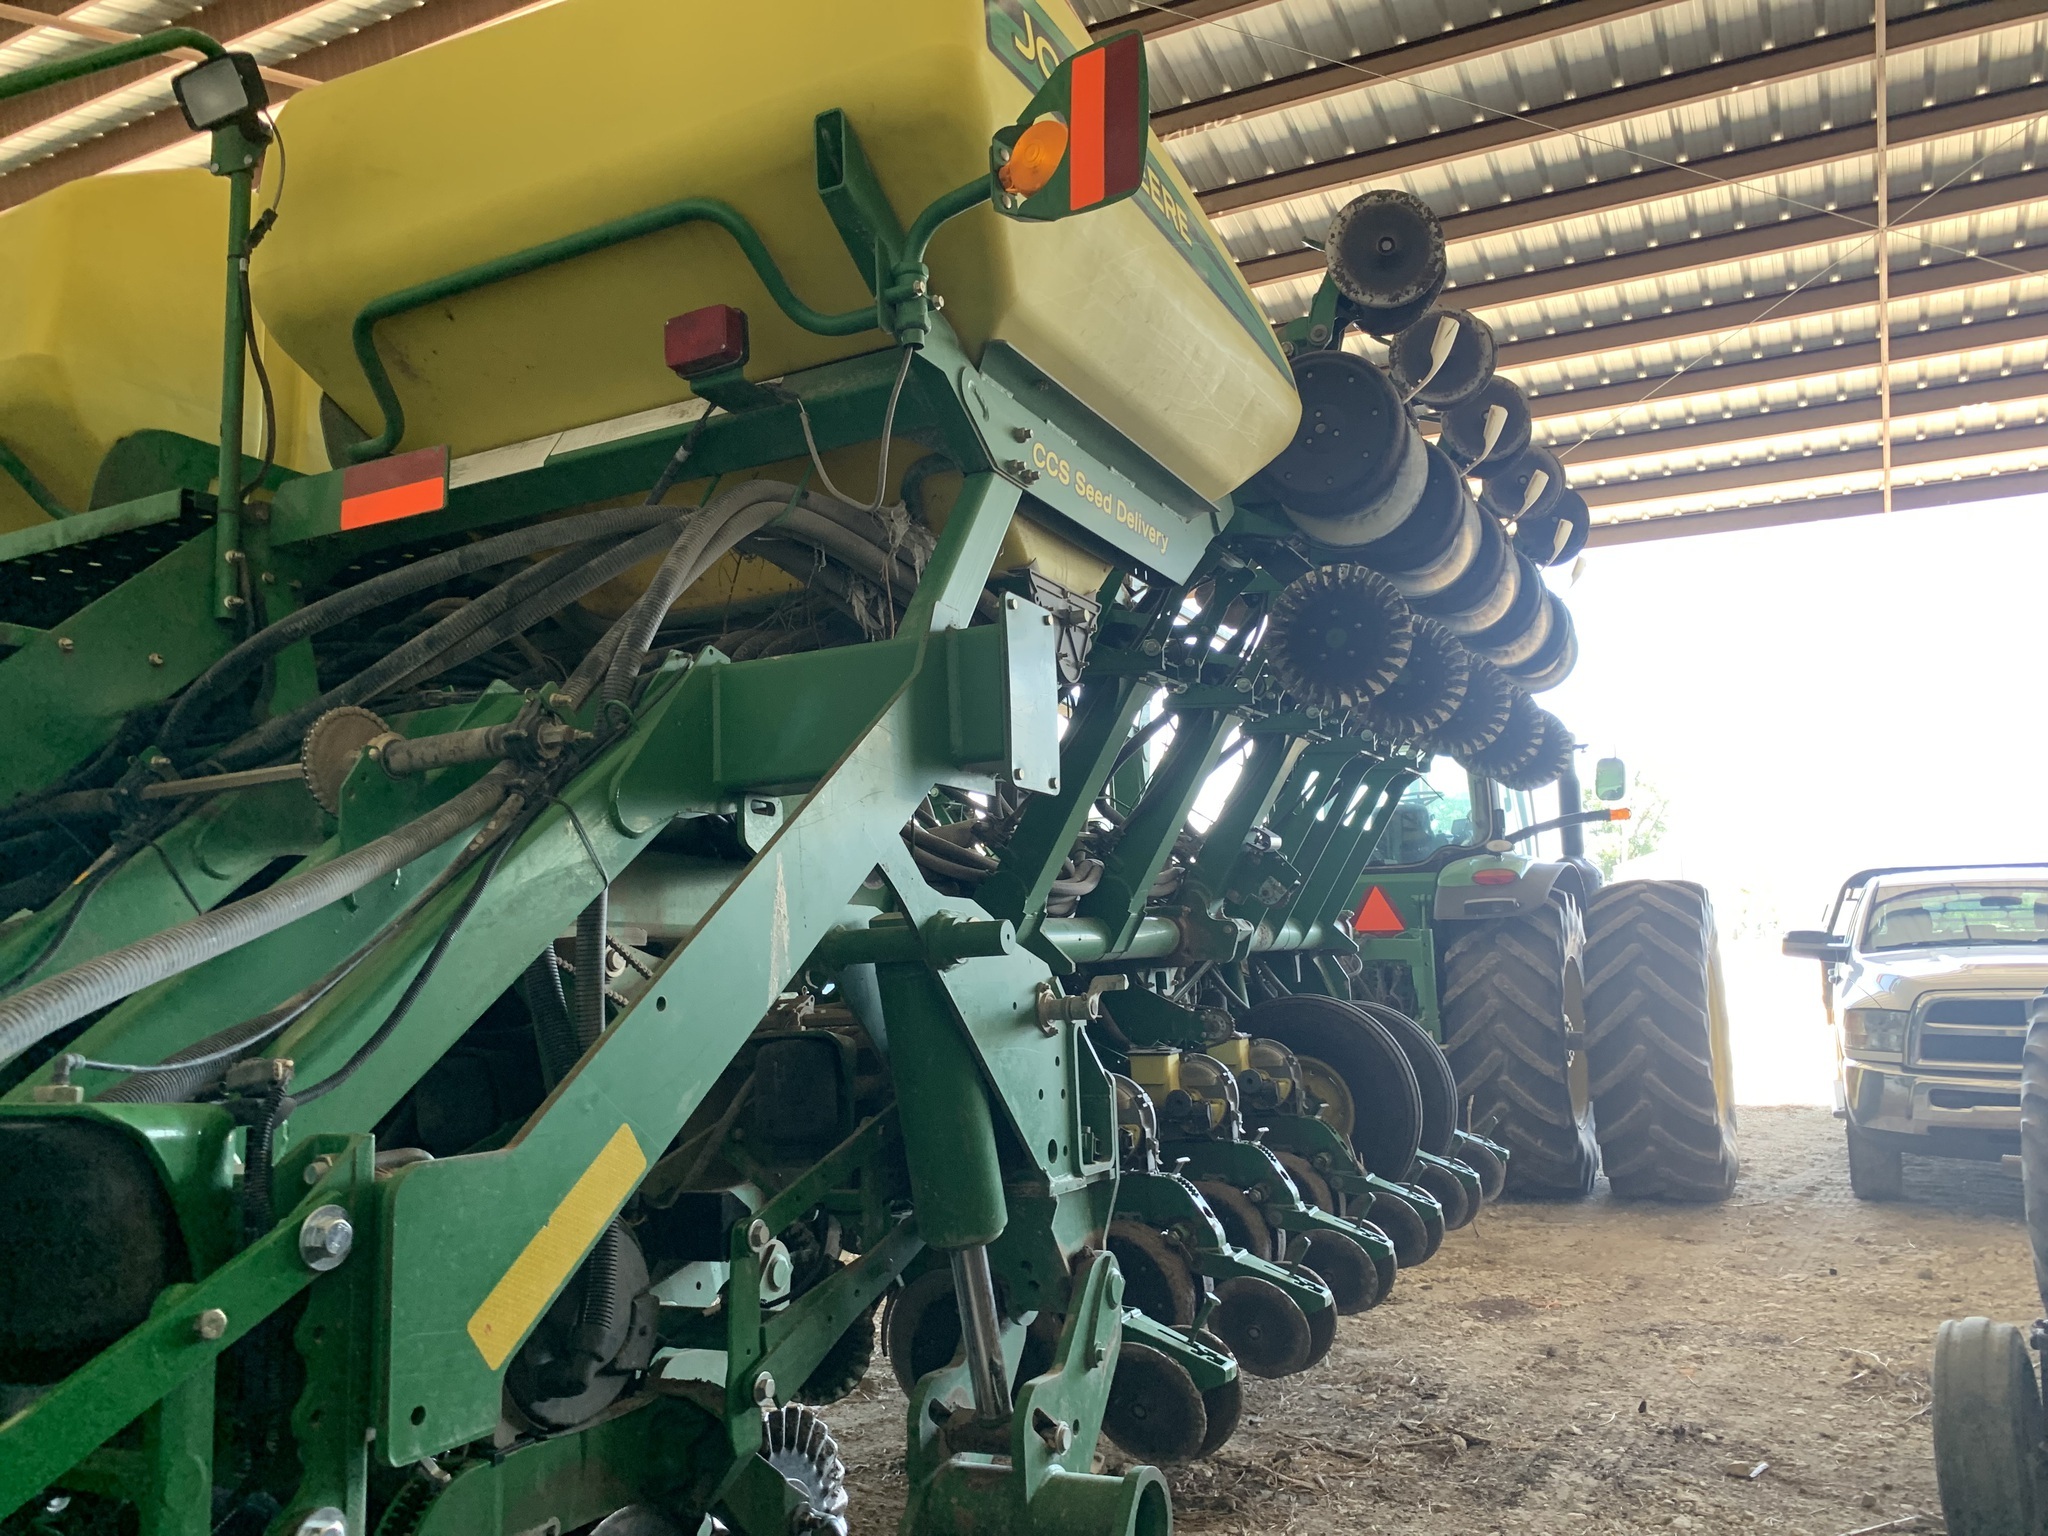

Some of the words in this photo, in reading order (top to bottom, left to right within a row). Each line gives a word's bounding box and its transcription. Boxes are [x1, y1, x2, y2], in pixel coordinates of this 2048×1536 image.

[1014, 9, 1060, 80] JO
[1141, 164, 1193, 248] ERE
[1032, 442, 1071, 486] CCS
[1074, 471, 1113, 515] Seed
[1115, 498, 1170, 555] Delivery
